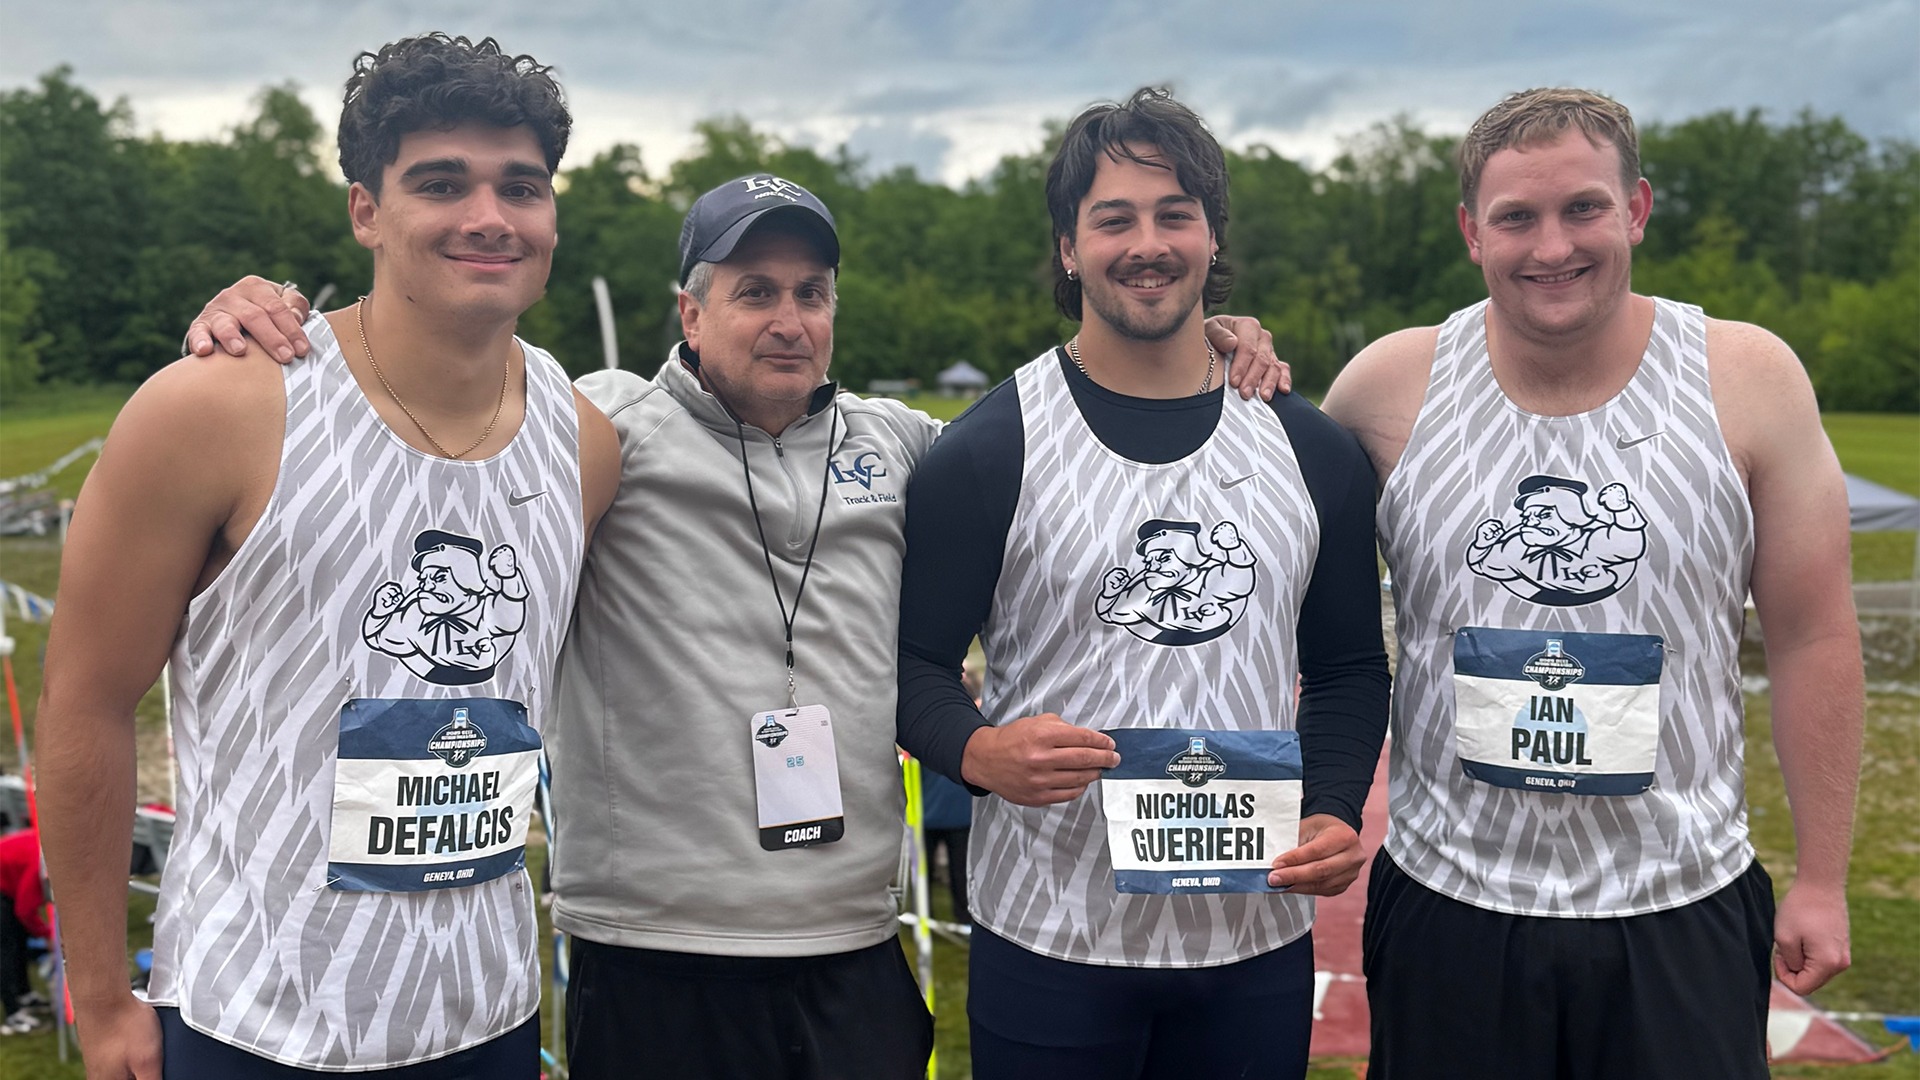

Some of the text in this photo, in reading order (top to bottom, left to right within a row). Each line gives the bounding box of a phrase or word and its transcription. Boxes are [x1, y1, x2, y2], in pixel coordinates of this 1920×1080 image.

[843, 493, 897, 506] Track & Field
[1525, 665, 1583, 676] CHAMPIONSHIPS
[1530, 695, 1574, 723] IAN
[430, 738, 486, 750] CHAMPIONSHIPS
[1511, 727, 1592, 766] PAUL
[786, 755, 805, 768] 25
[1168, 764, 1225, 772] CHAMPIONSHIPS
[397, 771, 500, 806] MICHAEL
[1136, 793, 1255, 820] NICHOLAS
[367, 805, 513, 856] DEFALCIS
[784, 825, 822, 844] COACH
[1131, 826, 1265, 863] GUERIERI
[456, 868, 475, 879] OHIO
[1202, 876, 1221, 887] OHIO
